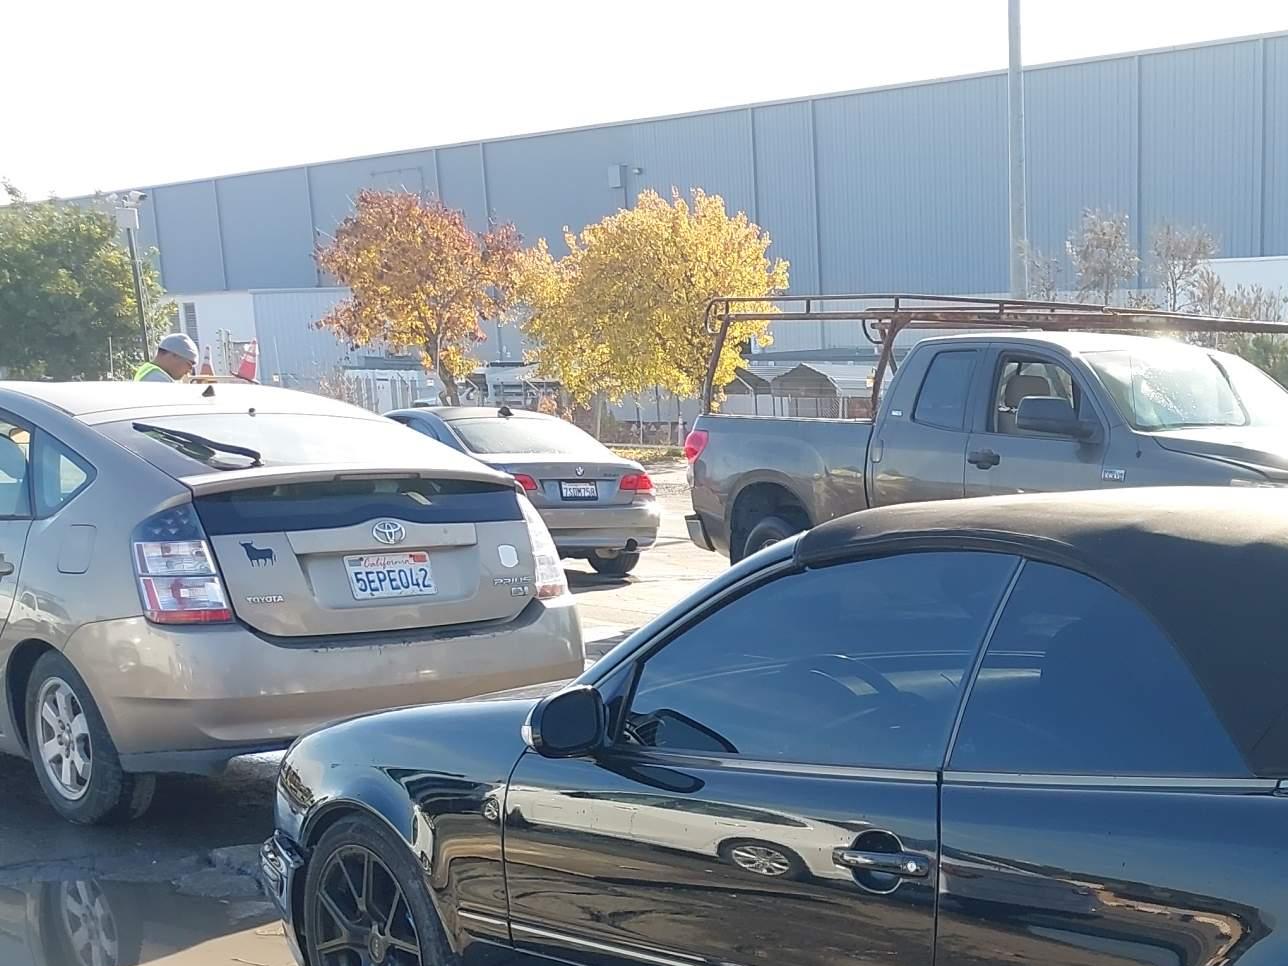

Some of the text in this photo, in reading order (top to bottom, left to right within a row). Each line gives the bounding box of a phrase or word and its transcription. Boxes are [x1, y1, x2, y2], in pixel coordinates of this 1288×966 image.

[362, 556, 414, 570] California
[353, 567, 432, 593] 5EPE042
[246, 595, 284, 604] TOYOTA
